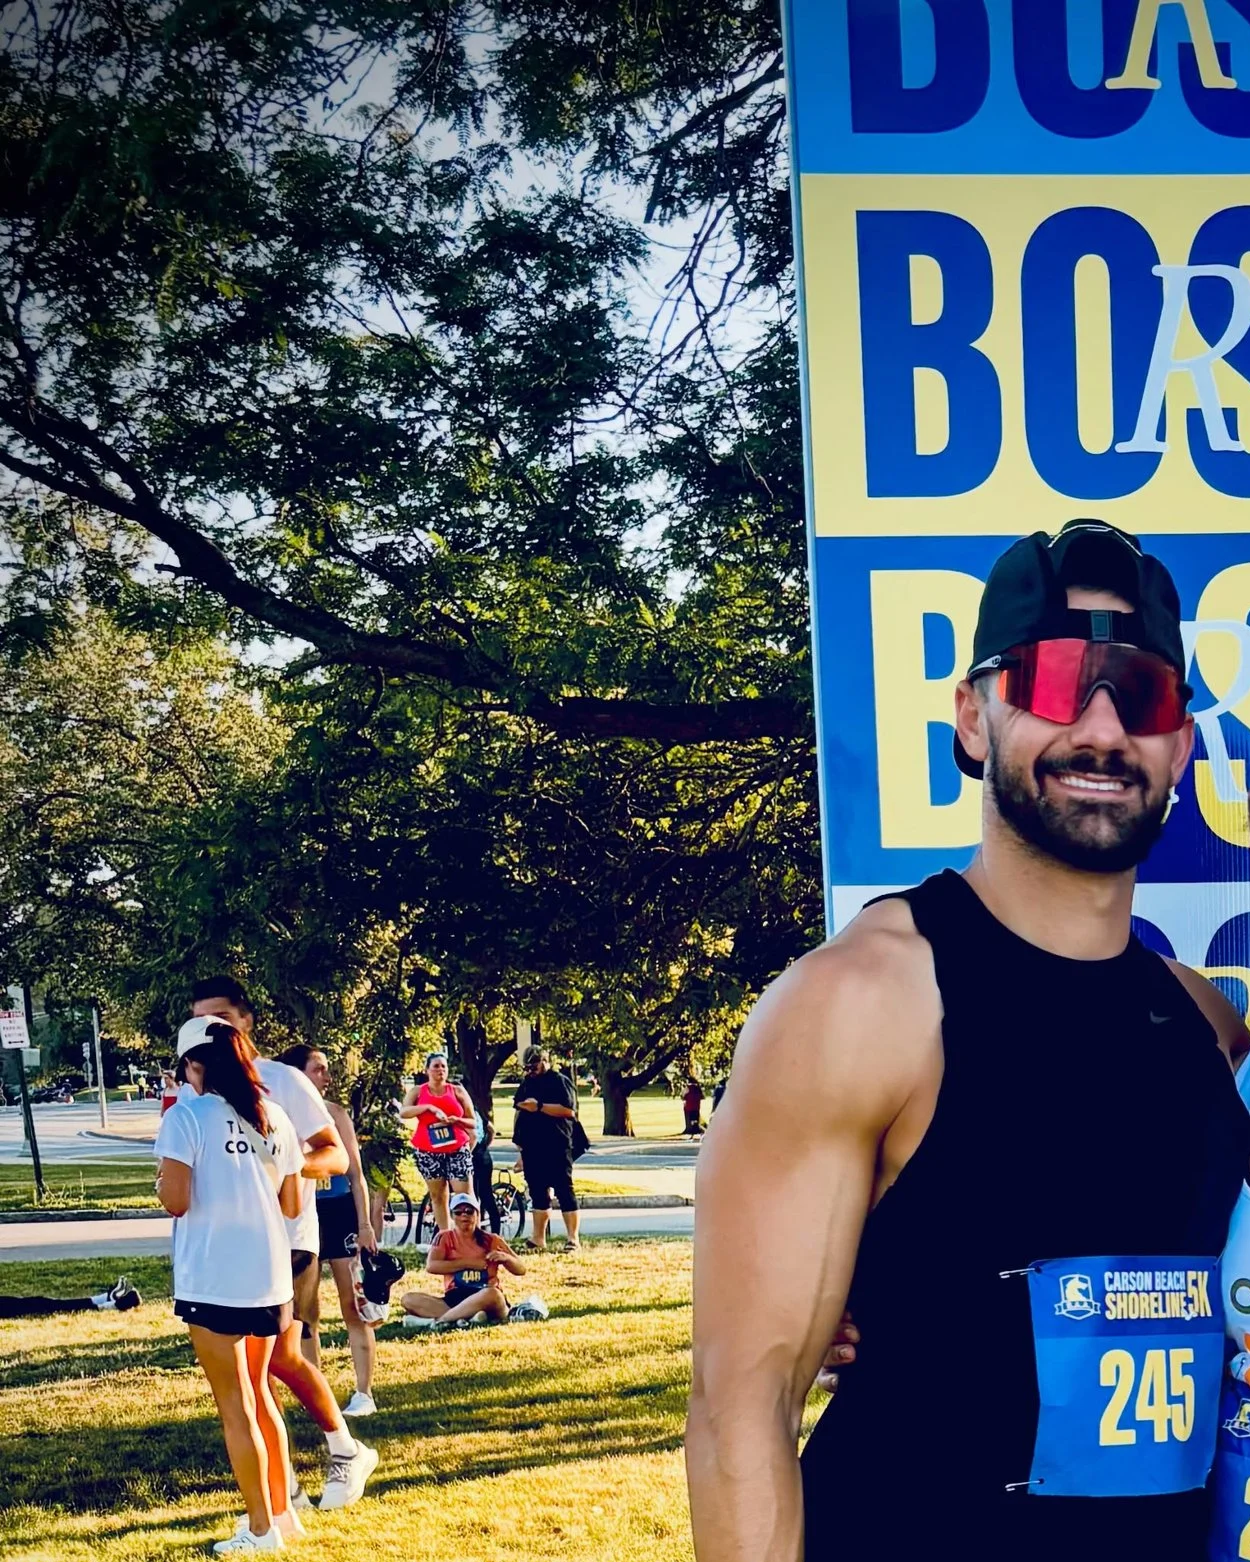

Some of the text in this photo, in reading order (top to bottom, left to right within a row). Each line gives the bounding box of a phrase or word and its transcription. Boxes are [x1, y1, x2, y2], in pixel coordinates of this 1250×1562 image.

[1103, 1270, 1186, 1292] CARSON BEACH
[1186, 1270, 1213, 1318] 5K
[1104, 1291, 1189, 1321] SHORELINE
[1099, 1347, 1196, 1446] 245
